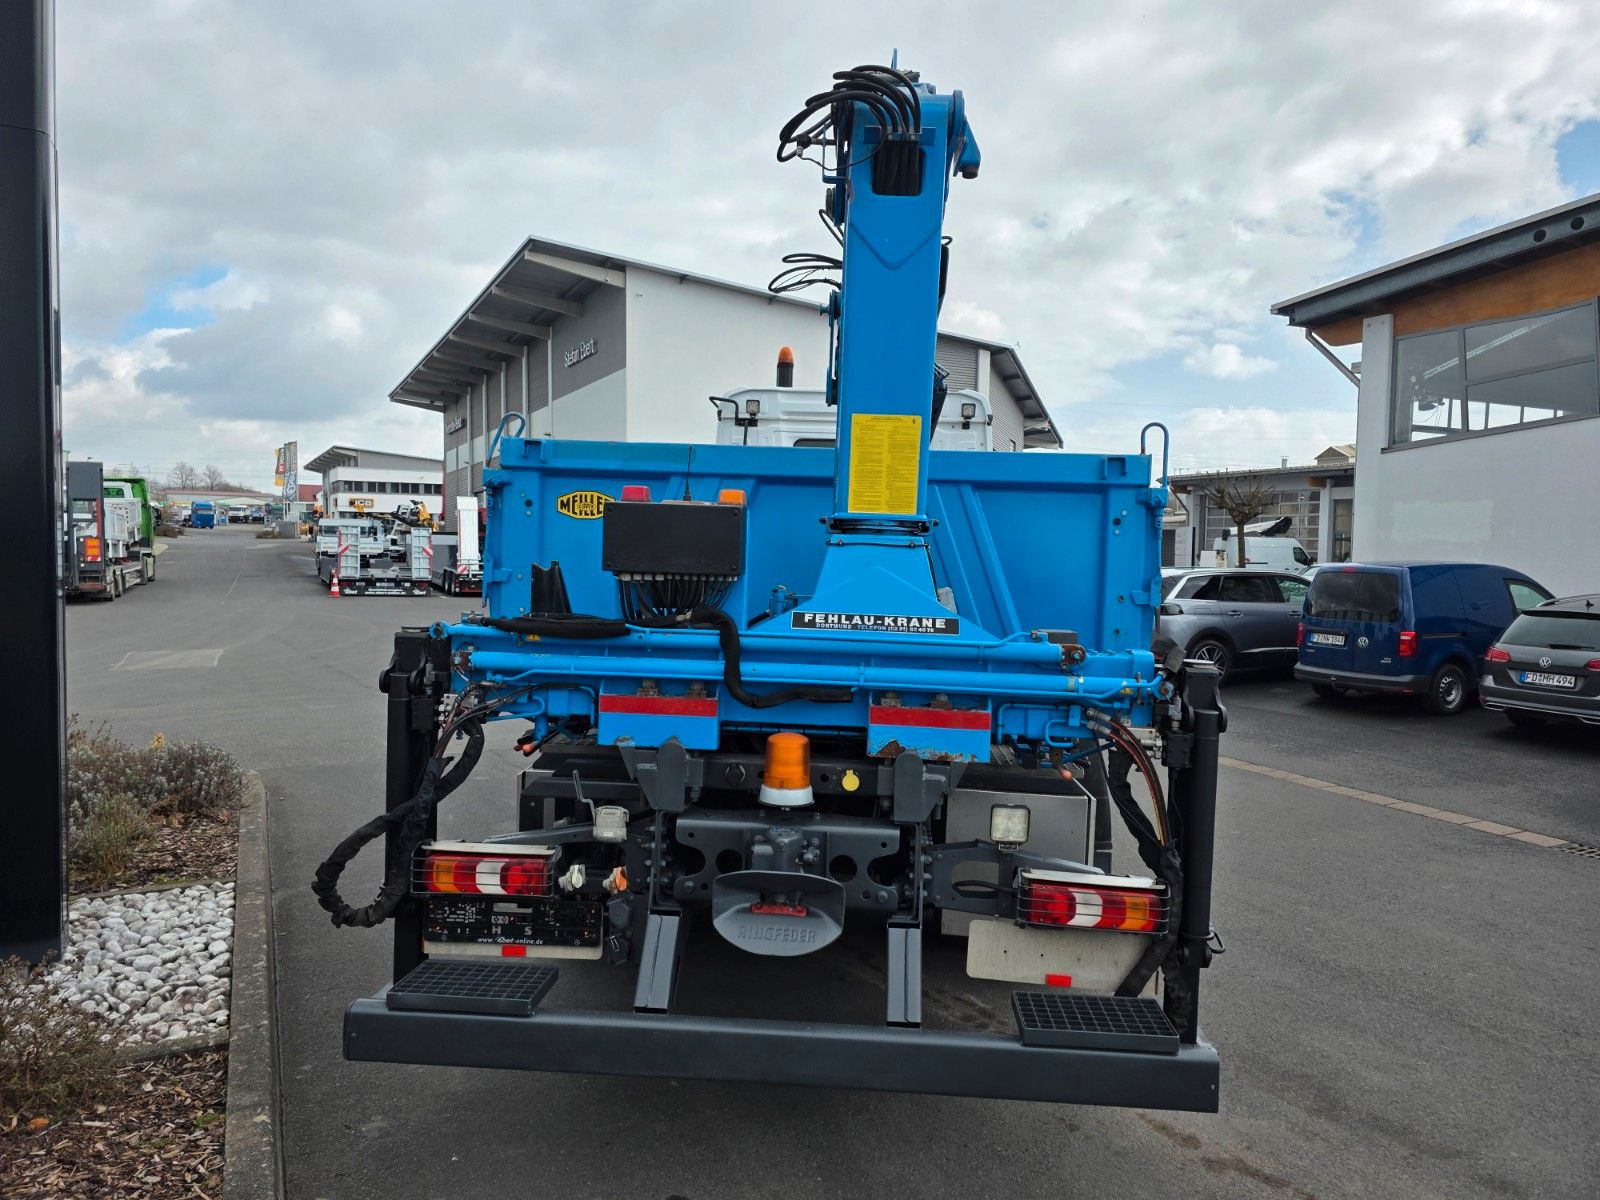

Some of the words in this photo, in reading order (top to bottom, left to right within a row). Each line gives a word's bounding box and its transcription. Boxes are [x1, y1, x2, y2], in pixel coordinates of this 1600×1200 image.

[560, 494, 610, 516] MEILLE
[804, 613, 946, 629] FEHLAU-KRANE
[816, 622, 852, 630] DORTMUND
[1525, 672, 1538, 682] FD
[1542, 674, 1555, 684] MH
[1556, 676, 1573, 685] 494
[737, 925, 817, 944] RINGFEDER
